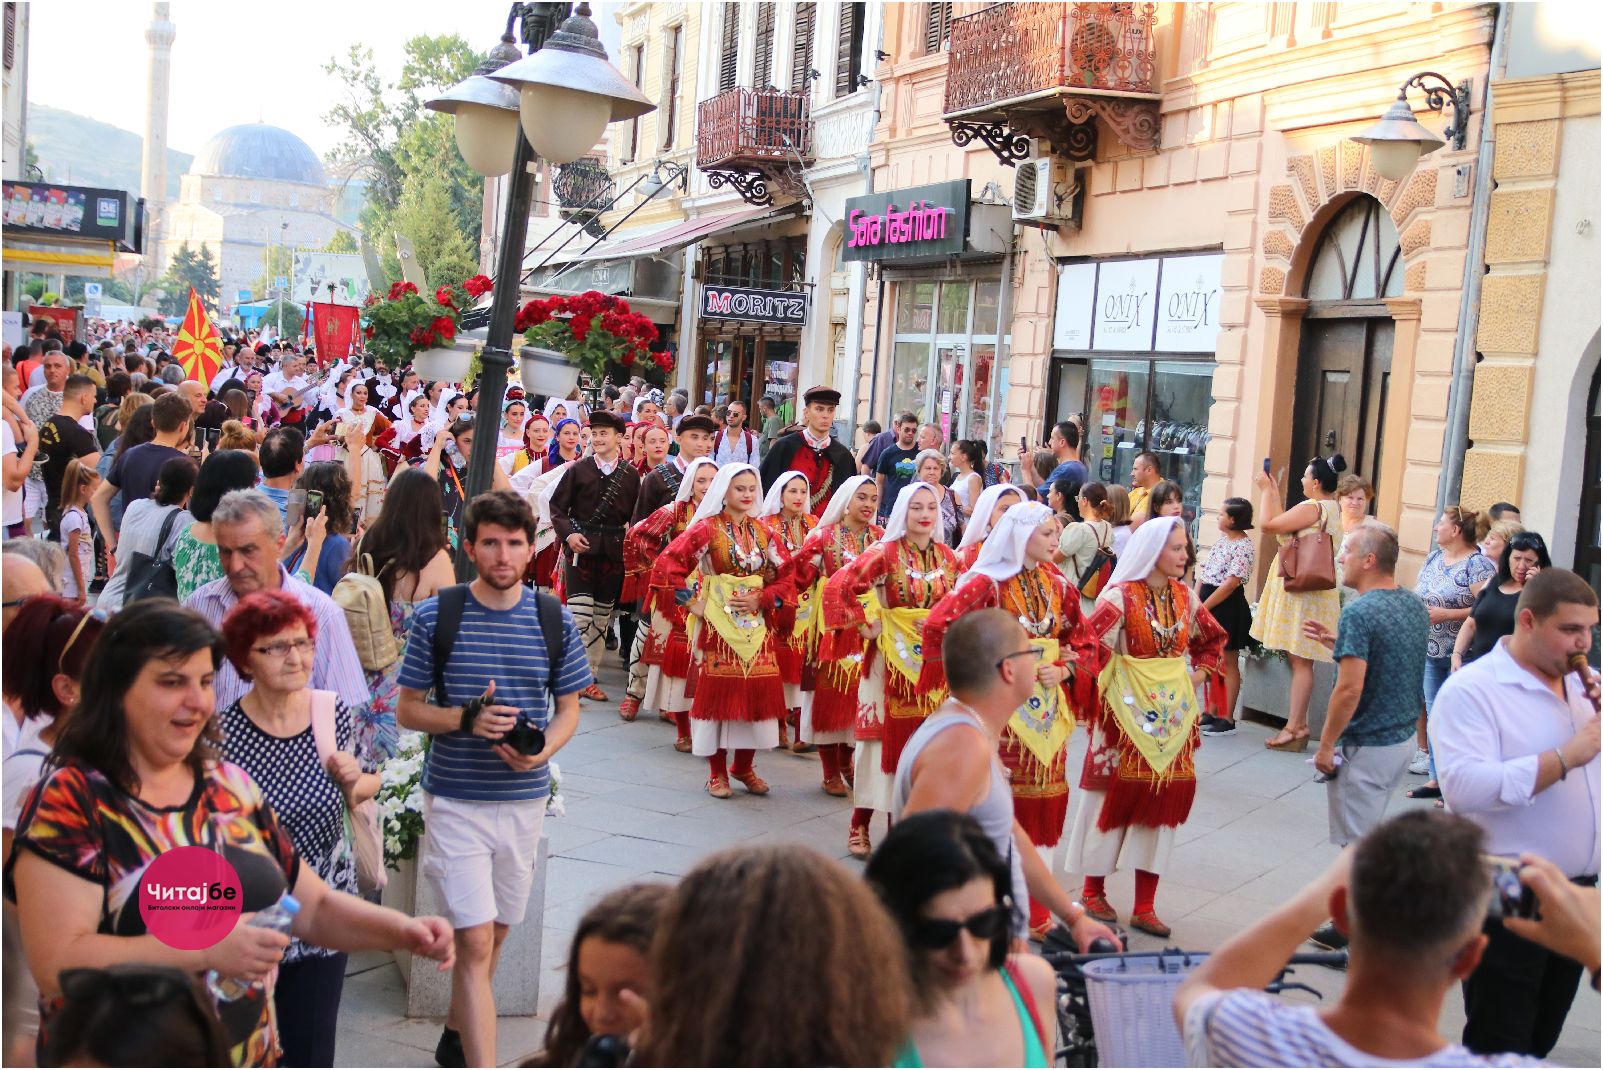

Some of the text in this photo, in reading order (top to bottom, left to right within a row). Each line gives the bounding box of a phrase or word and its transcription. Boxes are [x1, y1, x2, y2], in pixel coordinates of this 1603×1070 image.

[848, 200, 945, 247] Sara fashion
[707, 290, 804, 318] MORITZ
